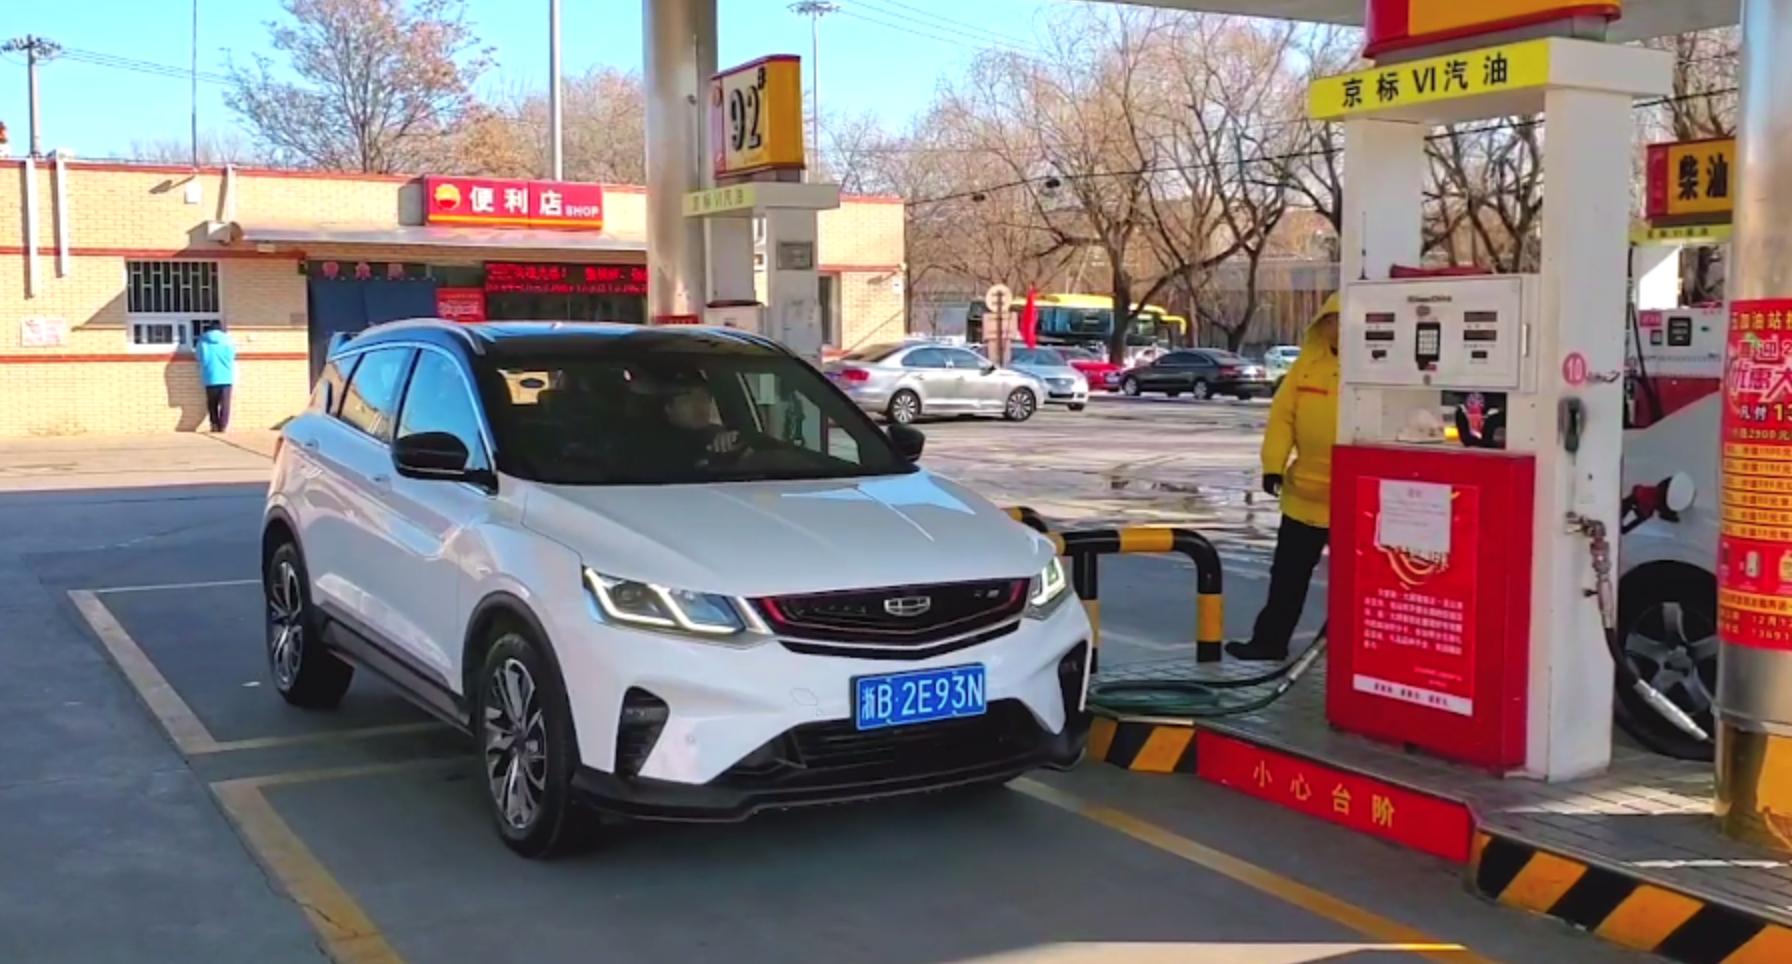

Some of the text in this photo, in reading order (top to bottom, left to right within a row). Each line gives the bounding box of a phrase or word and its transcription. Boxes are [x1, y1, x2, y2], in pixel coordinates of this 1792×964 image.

[1678, 152, 1728, 200] 柴油
[469, 185, 599, 218] 便利店 SHOP
[1567, 357, 1583, 382] 10
[1252, 759, 1396, 829] 小心台阶
